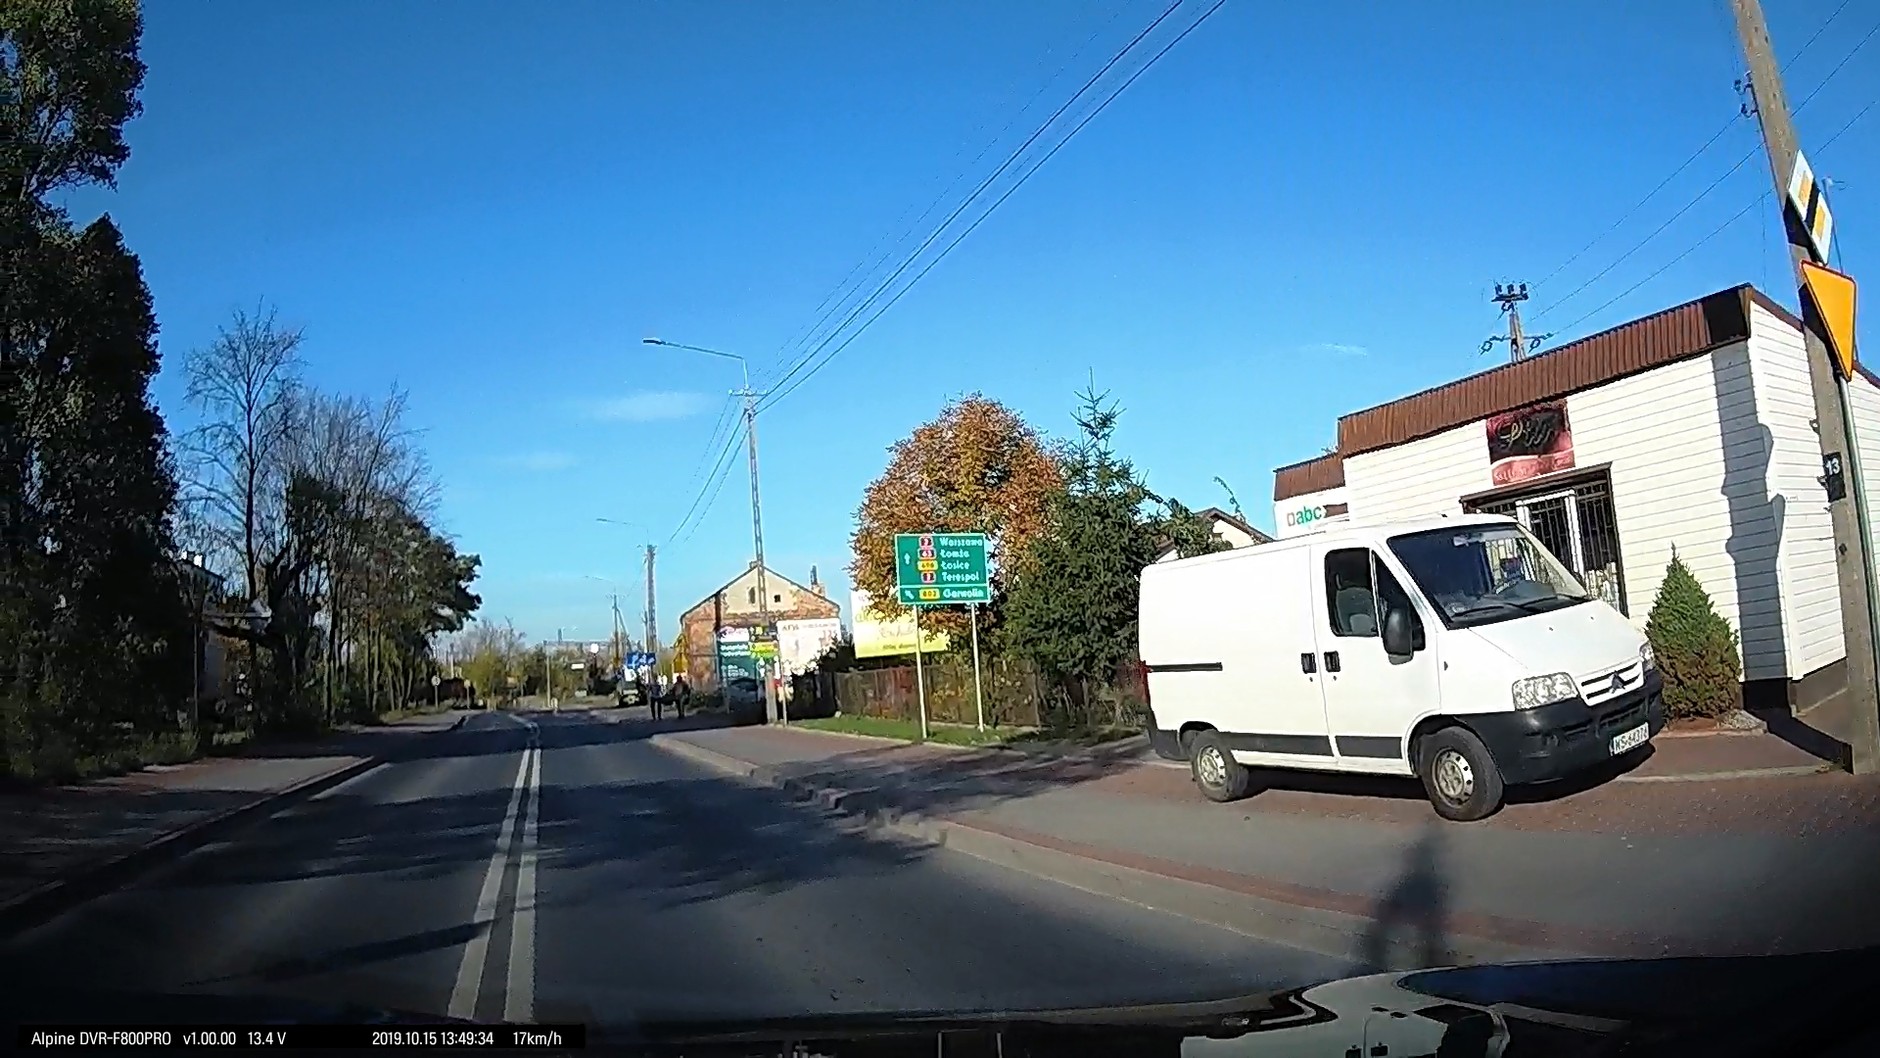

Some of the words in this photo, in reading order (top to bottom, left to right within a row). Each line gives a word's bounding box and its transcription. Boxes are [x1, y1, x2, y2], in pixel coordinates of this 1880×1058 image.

[1825, 457, 1841, 476] 13
[939, 537, 983, 546] Warszawa
[941, 571, 980, 582] Terespol
[943, 588, 984, 598] Garwolin
